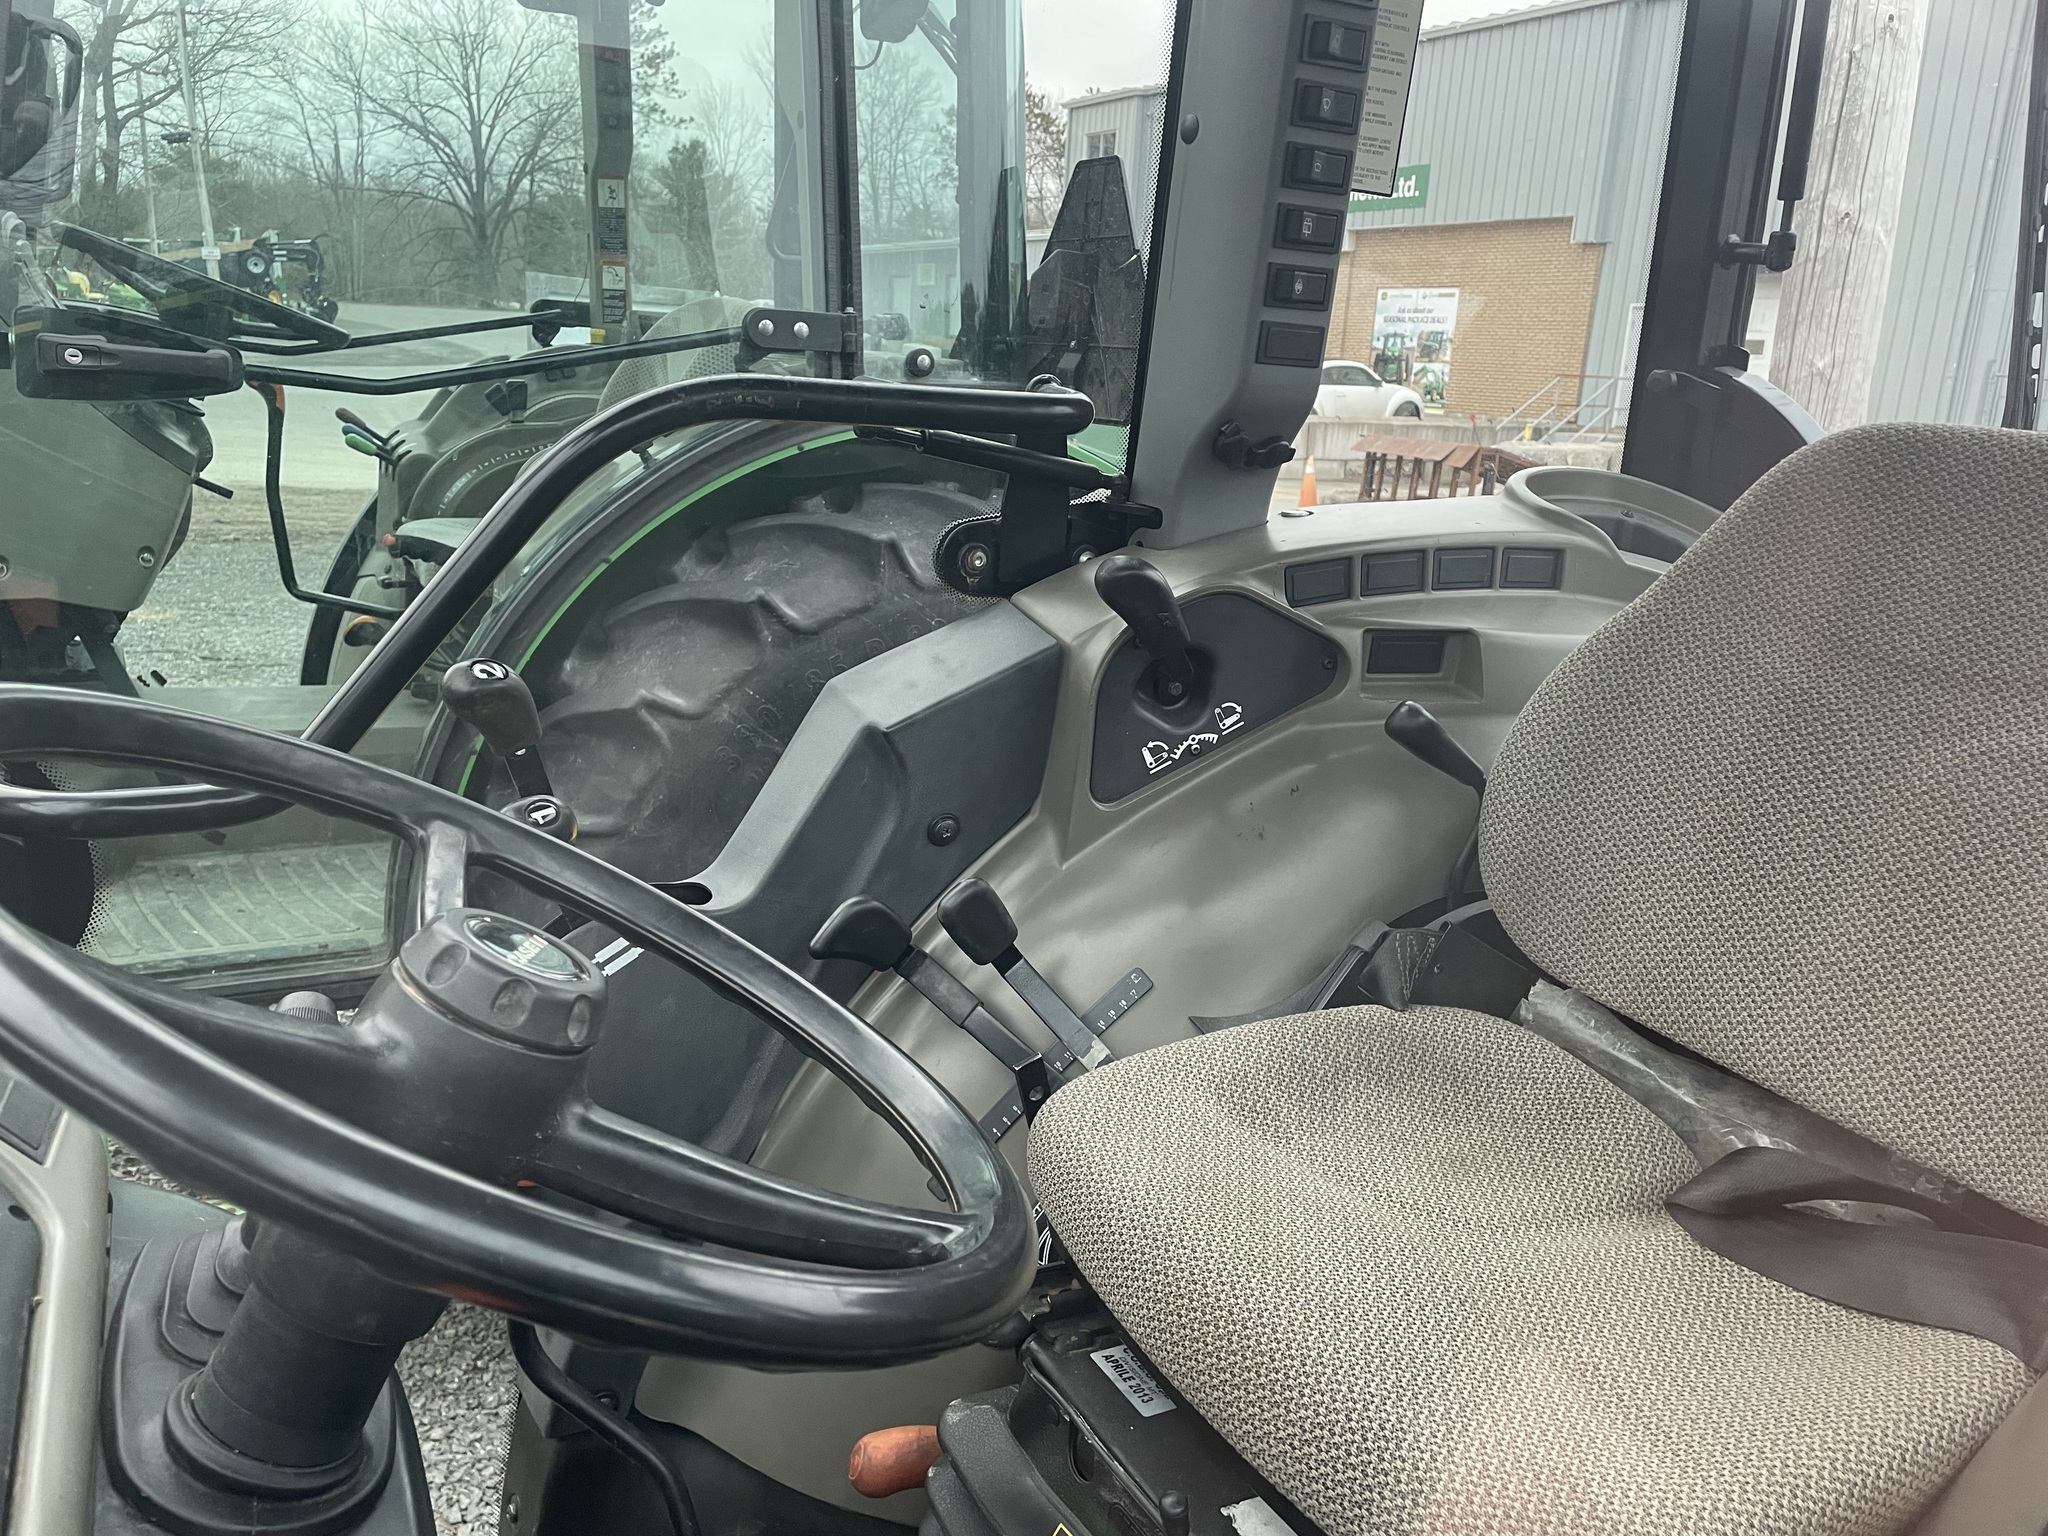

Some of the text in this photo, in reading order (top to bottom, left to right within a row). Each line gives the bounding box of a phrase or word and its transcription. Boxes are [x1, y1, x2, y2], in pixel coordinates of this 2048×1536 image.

[473, 662, 504, 680] 2
[528, 806, 556, 824] A
[1102, 1354, 1154, 1404] APRILE 2013
